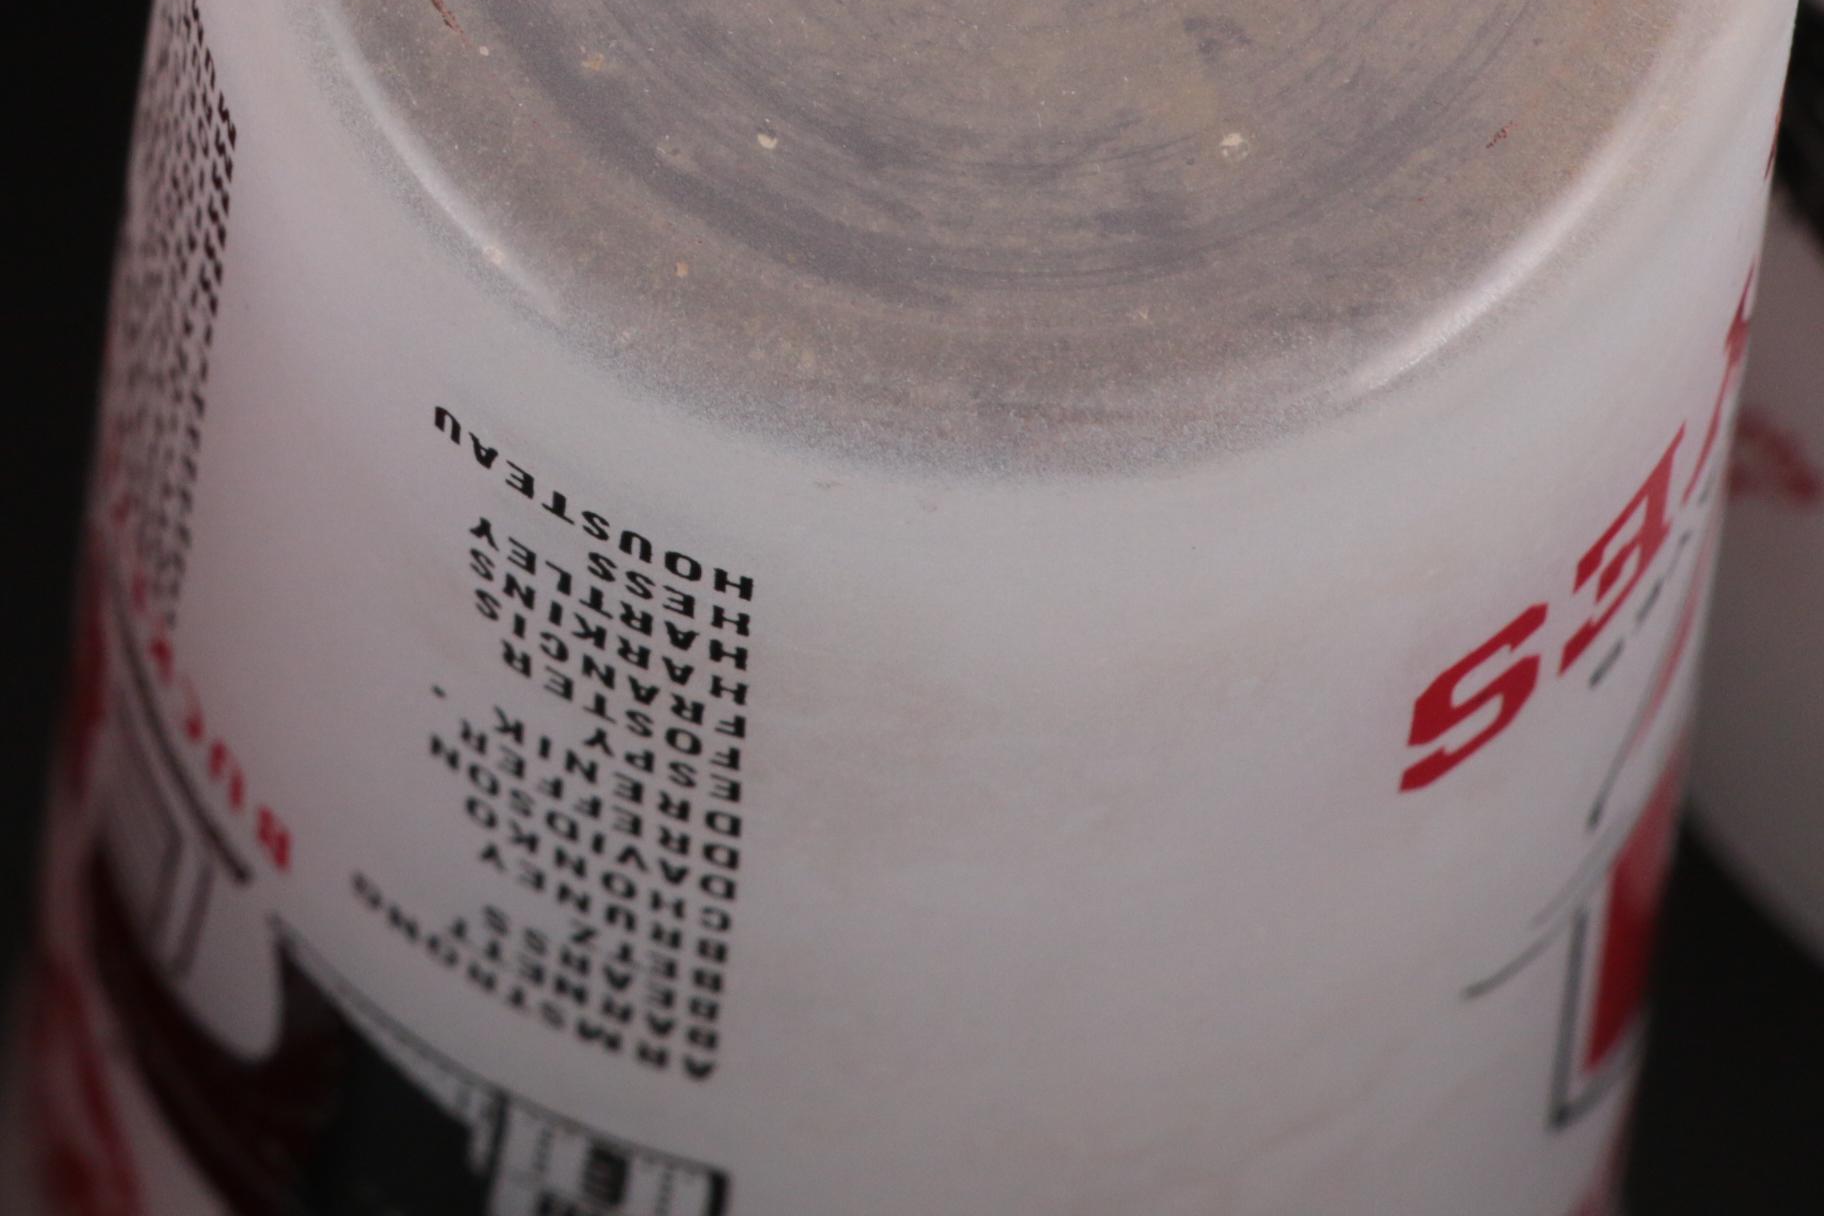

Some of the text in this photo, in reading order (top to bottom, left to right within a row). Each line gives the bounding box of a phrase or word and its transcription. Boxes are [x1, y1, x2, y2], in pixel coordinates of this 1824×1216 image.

[434, 406, 754, 601] HOUSTEAU
[469, 517, 750, 671] HARTLEY
[469, 548, 748, 706] HARKINS
[587, 551, 750, 637] HESS
[474, 588, 747, 739] FRANCIS
[501, 639, 741, 772] FOSTER
[430, 734, 737, 901] DAVIDSON
[494, 705, 742, 838] DRENIK
[584, 727, 742, 804] ESPY
[465, 796, 732, 933] CHONKO
[480, 842, 728, 964] BRUNEY
[350, 869, 717, 1081] ARMSTRONG
[447, 915, 720, 1051] BARNETT
[571, 920, 725, 992] BETZ
